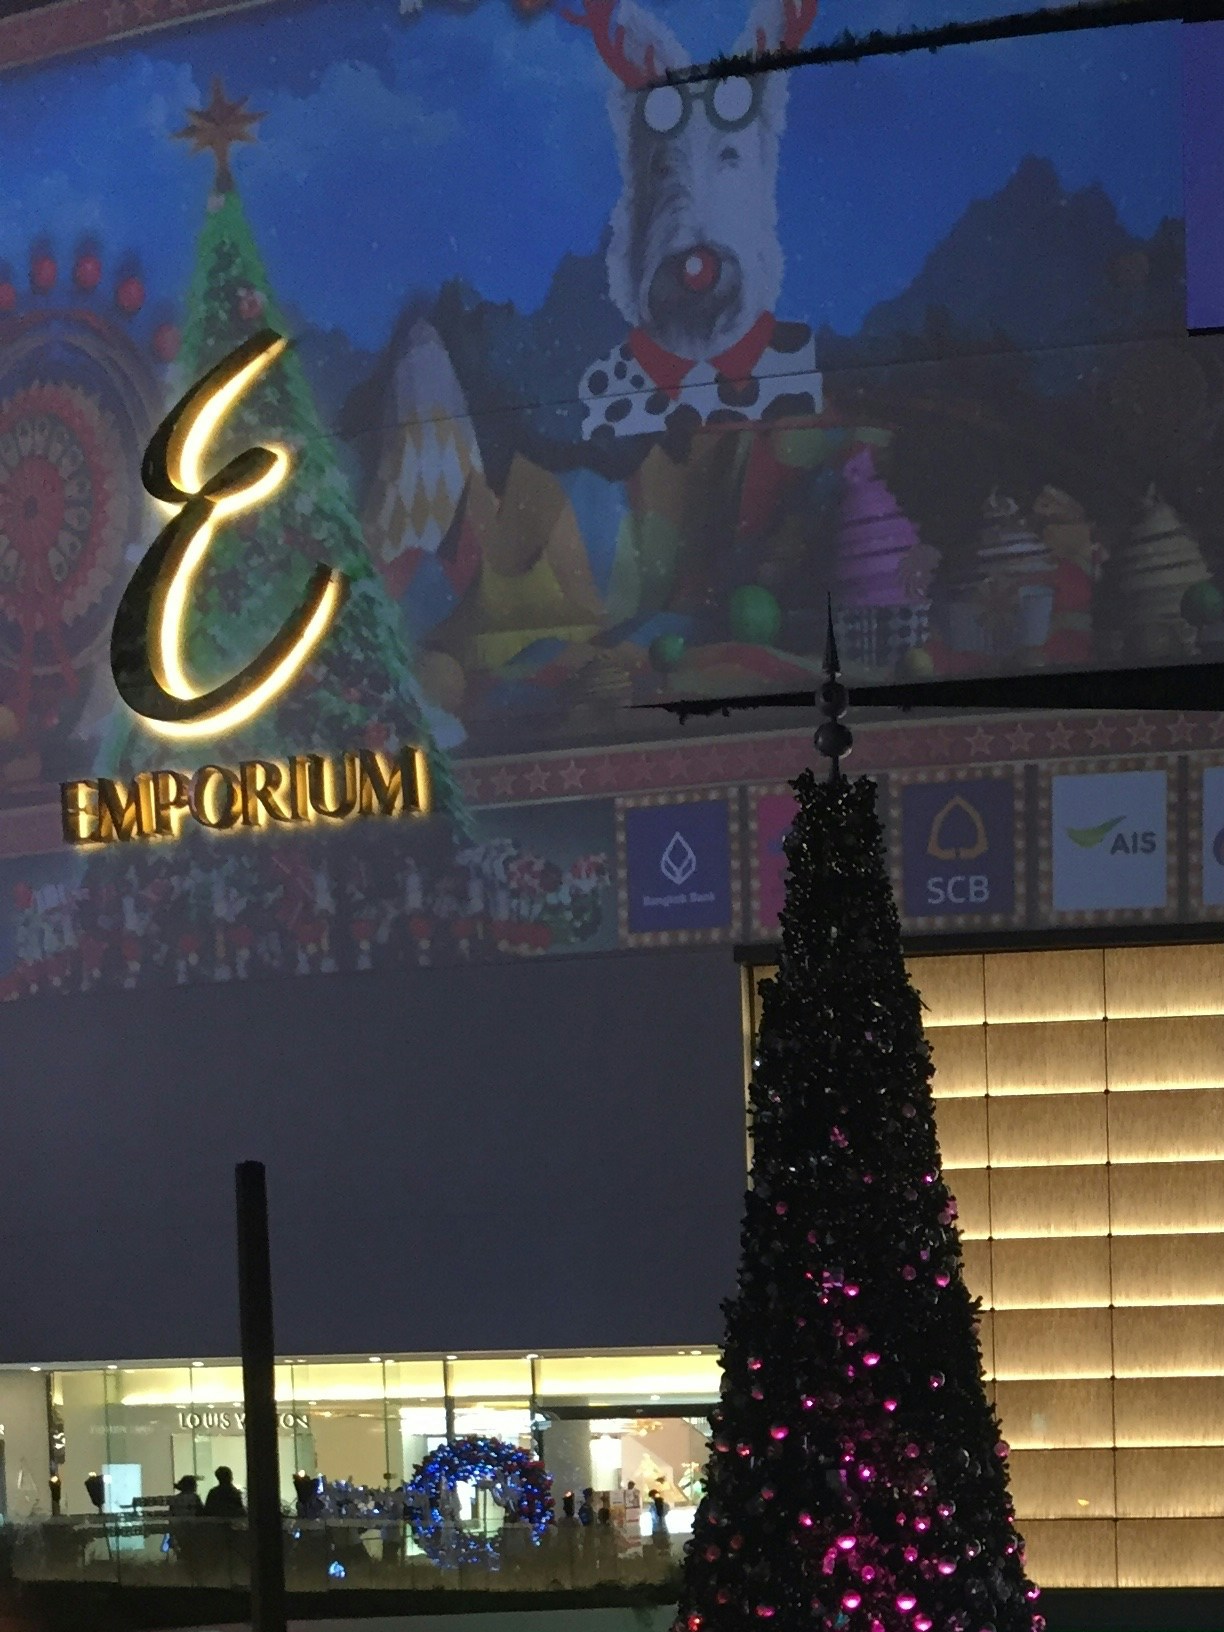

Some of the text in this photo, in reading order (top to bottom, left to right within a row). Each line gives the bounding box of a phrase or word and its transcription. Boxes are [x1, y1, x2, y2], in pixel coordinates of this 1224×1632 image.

[59, 746, 430, 846] EMPORIUM
[1110, 831, 1157, 855] AIS
[926, 874, 990, 906] SCB
[178, 1411, 231, 1430] LOUIS
